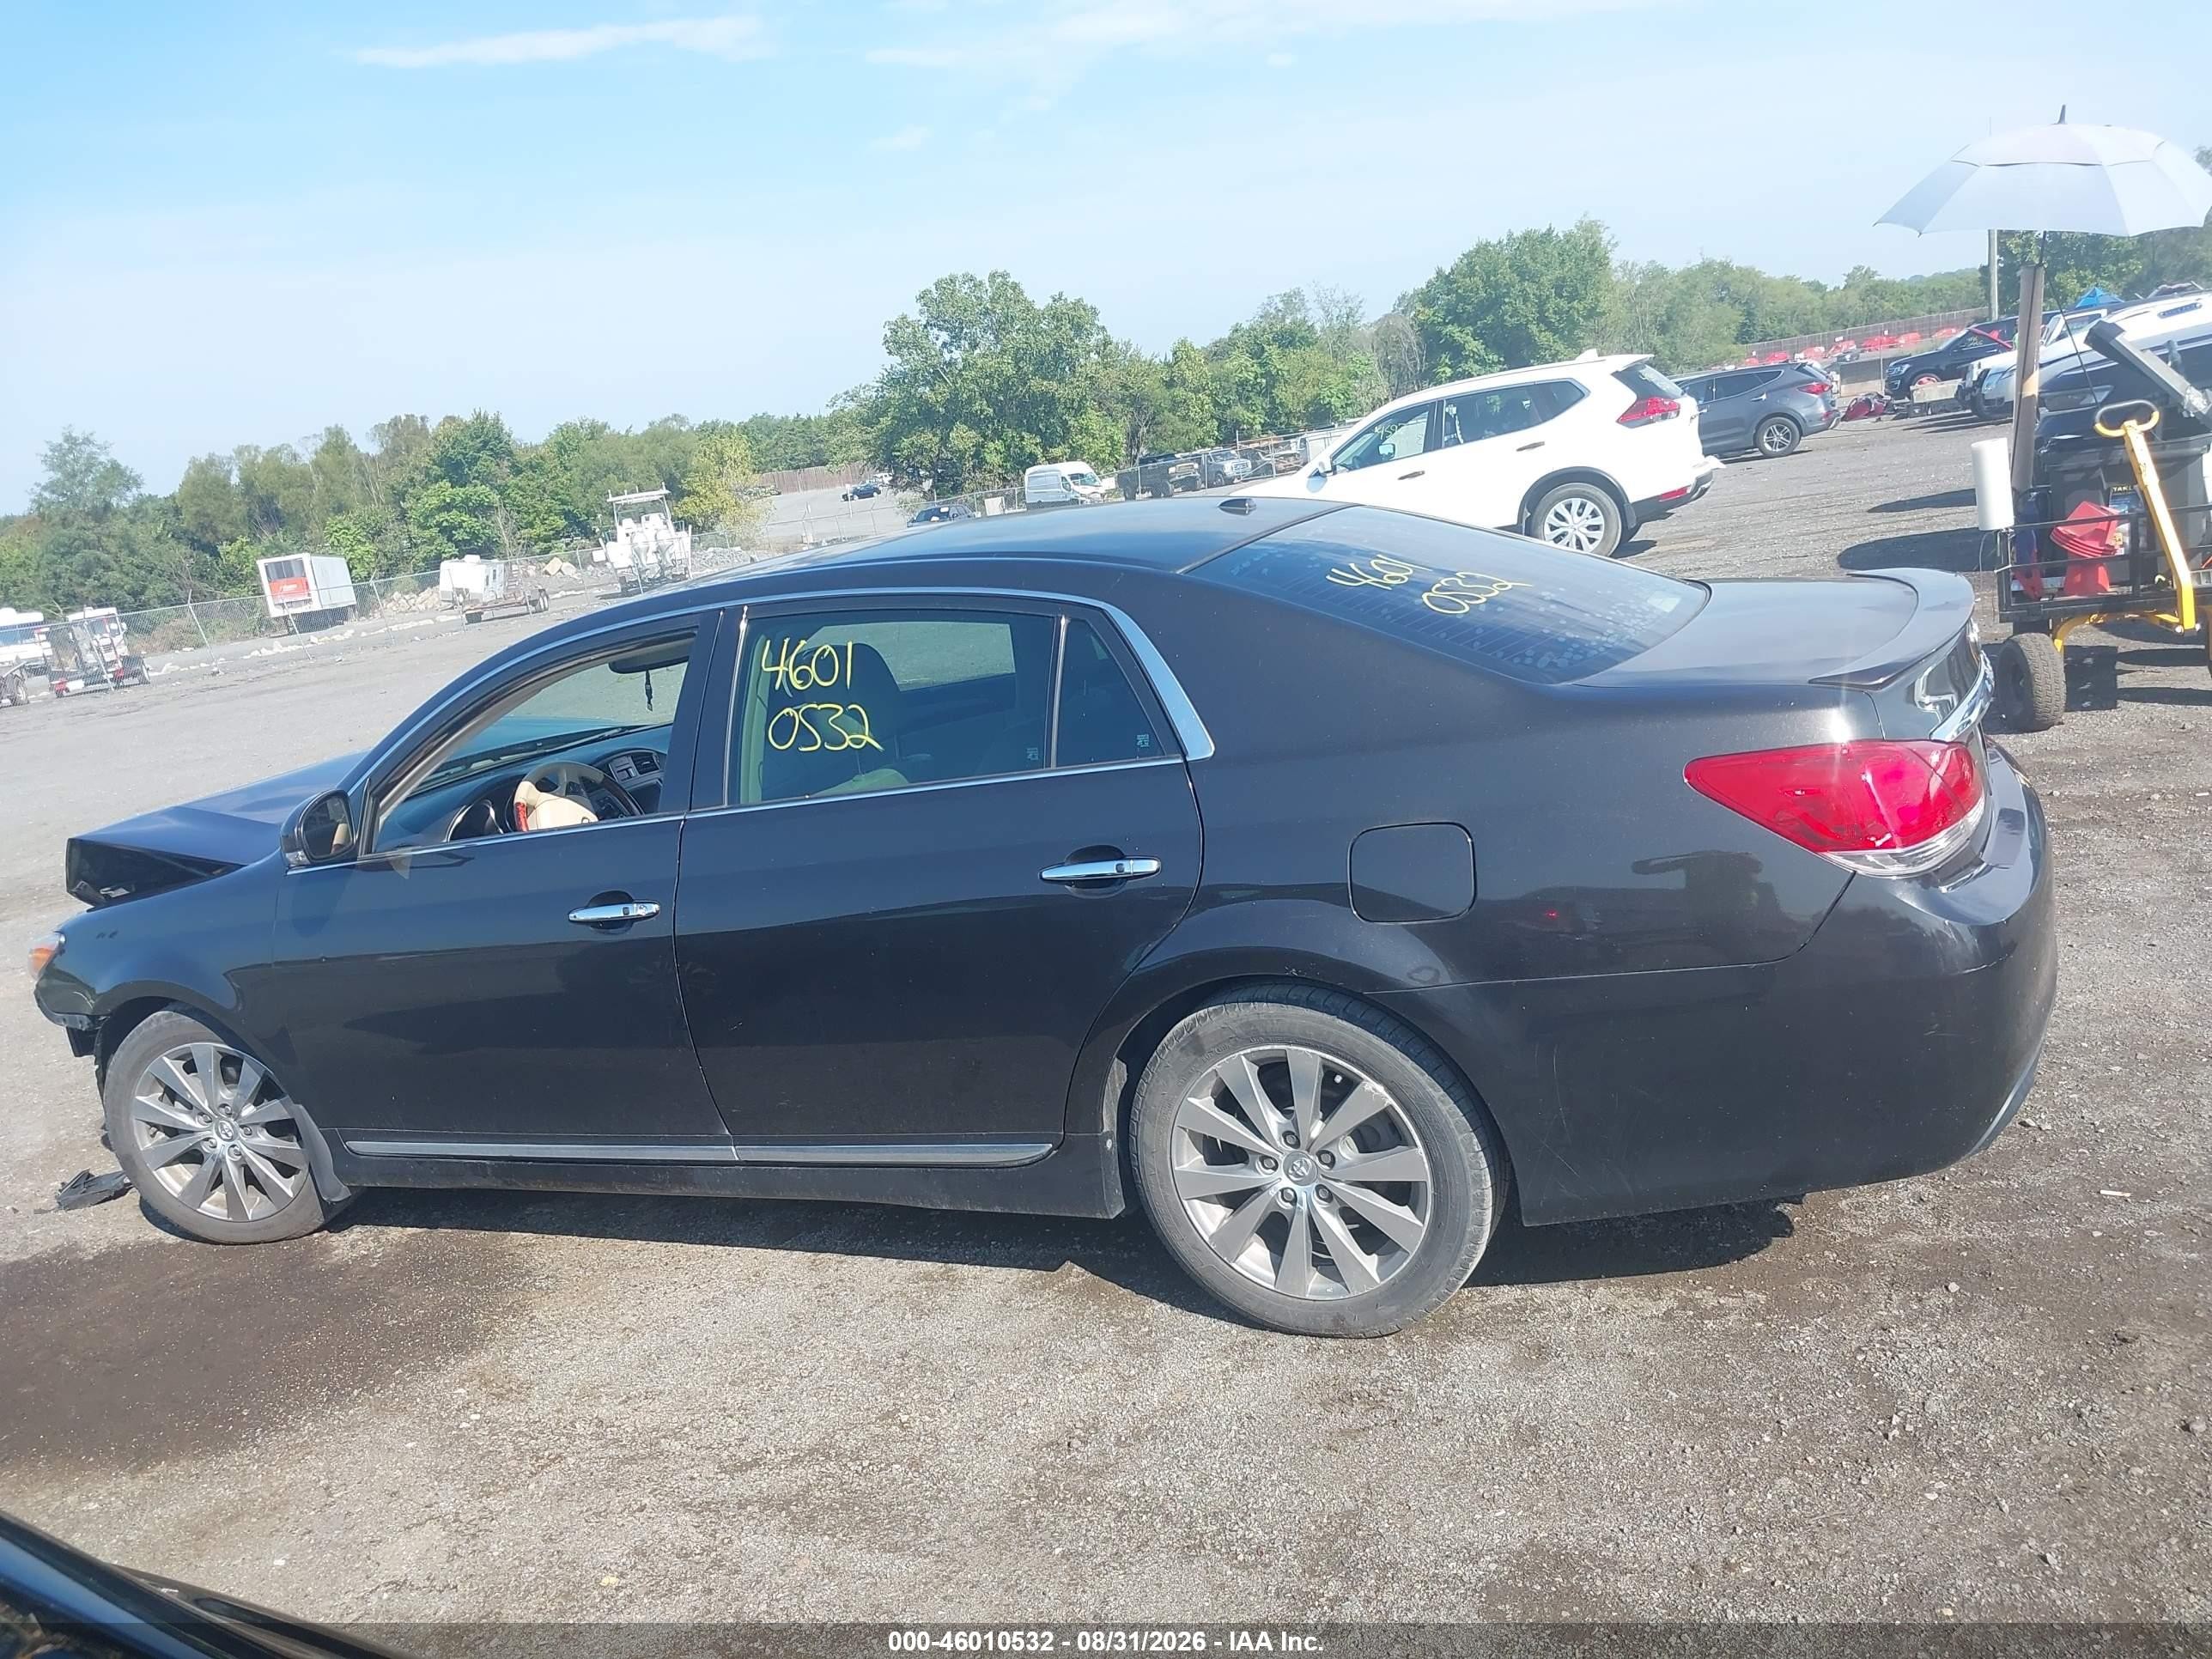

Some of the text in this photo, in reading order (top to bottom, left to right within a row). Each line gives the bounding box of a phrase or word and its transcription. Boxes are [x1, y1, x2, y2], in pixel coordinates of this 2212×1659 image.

[1326, 554, 1434, 591] 4601
[1421, 571, 1533, 615] 0532
[761, 637, 853, 690] 4601
[768, 702, 884, 752] 0532
